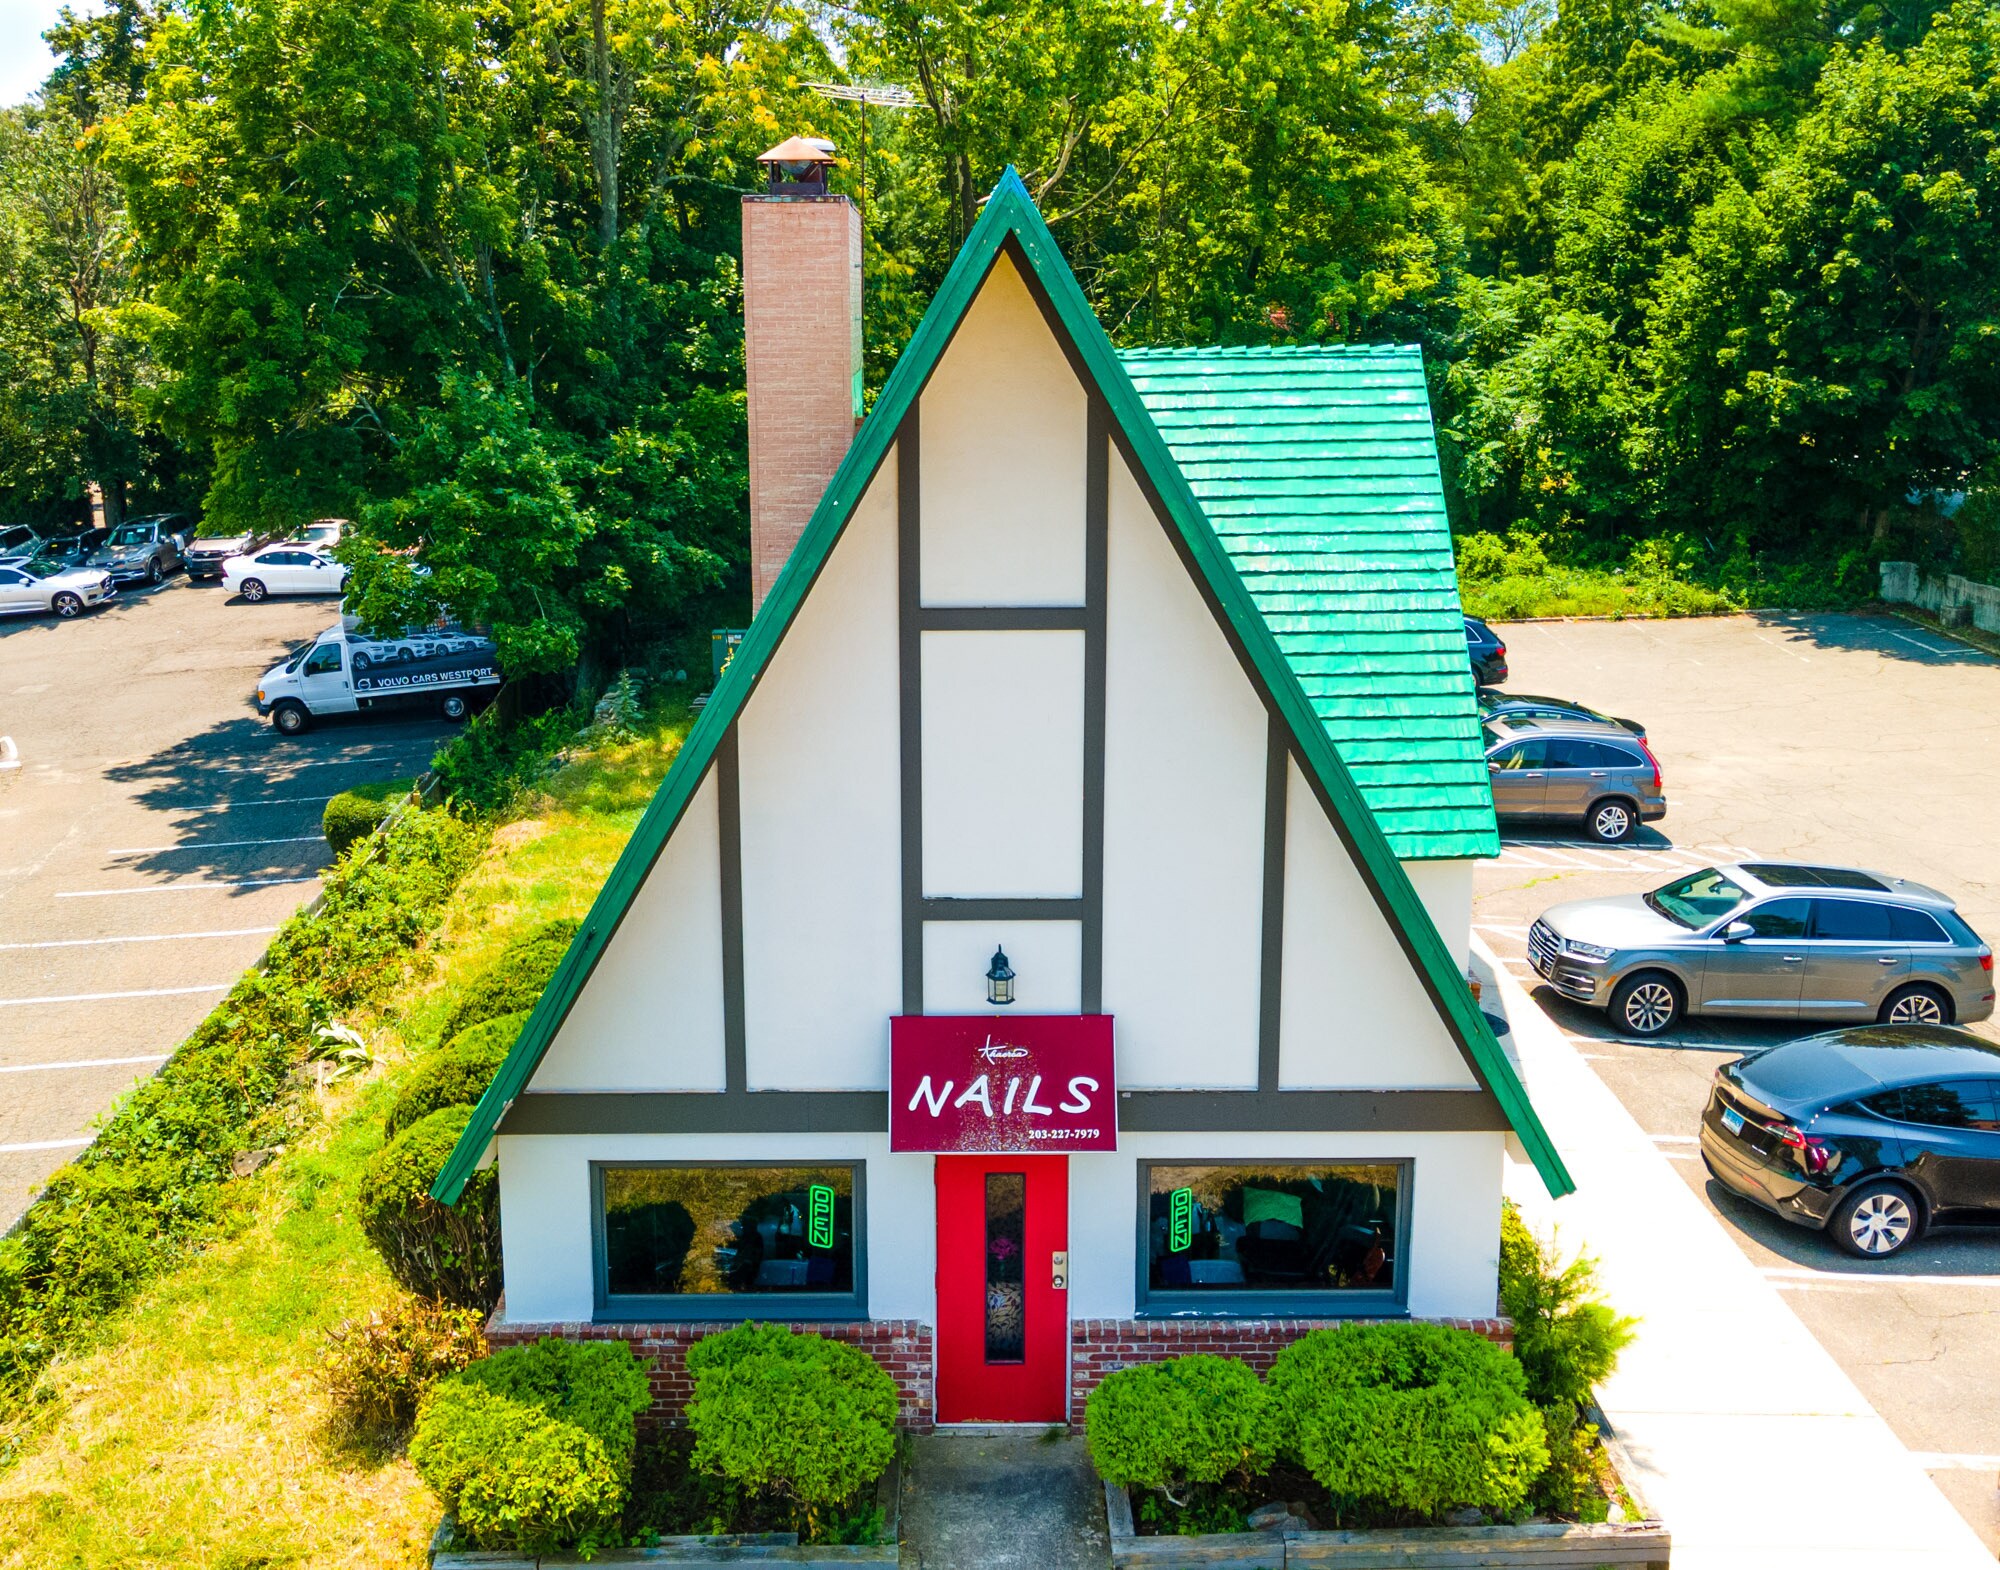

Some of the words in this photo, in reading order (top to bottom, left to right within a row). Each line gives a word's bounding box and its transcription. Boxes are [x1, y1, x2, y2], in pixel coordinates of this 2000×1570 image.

[378, 676, 409, 687] VOLVO
[411, 673, 438, 684] CARS
[440, 667, 493, 681] WESTPORT
[908, 1074, 1100, 1118] NAILS
[1028, 1128, 1100, 1140] 203-227-7979
[813, 1189, 830, 1245] OPEN
[1174, 1191, 1189, 1249] OPEN
